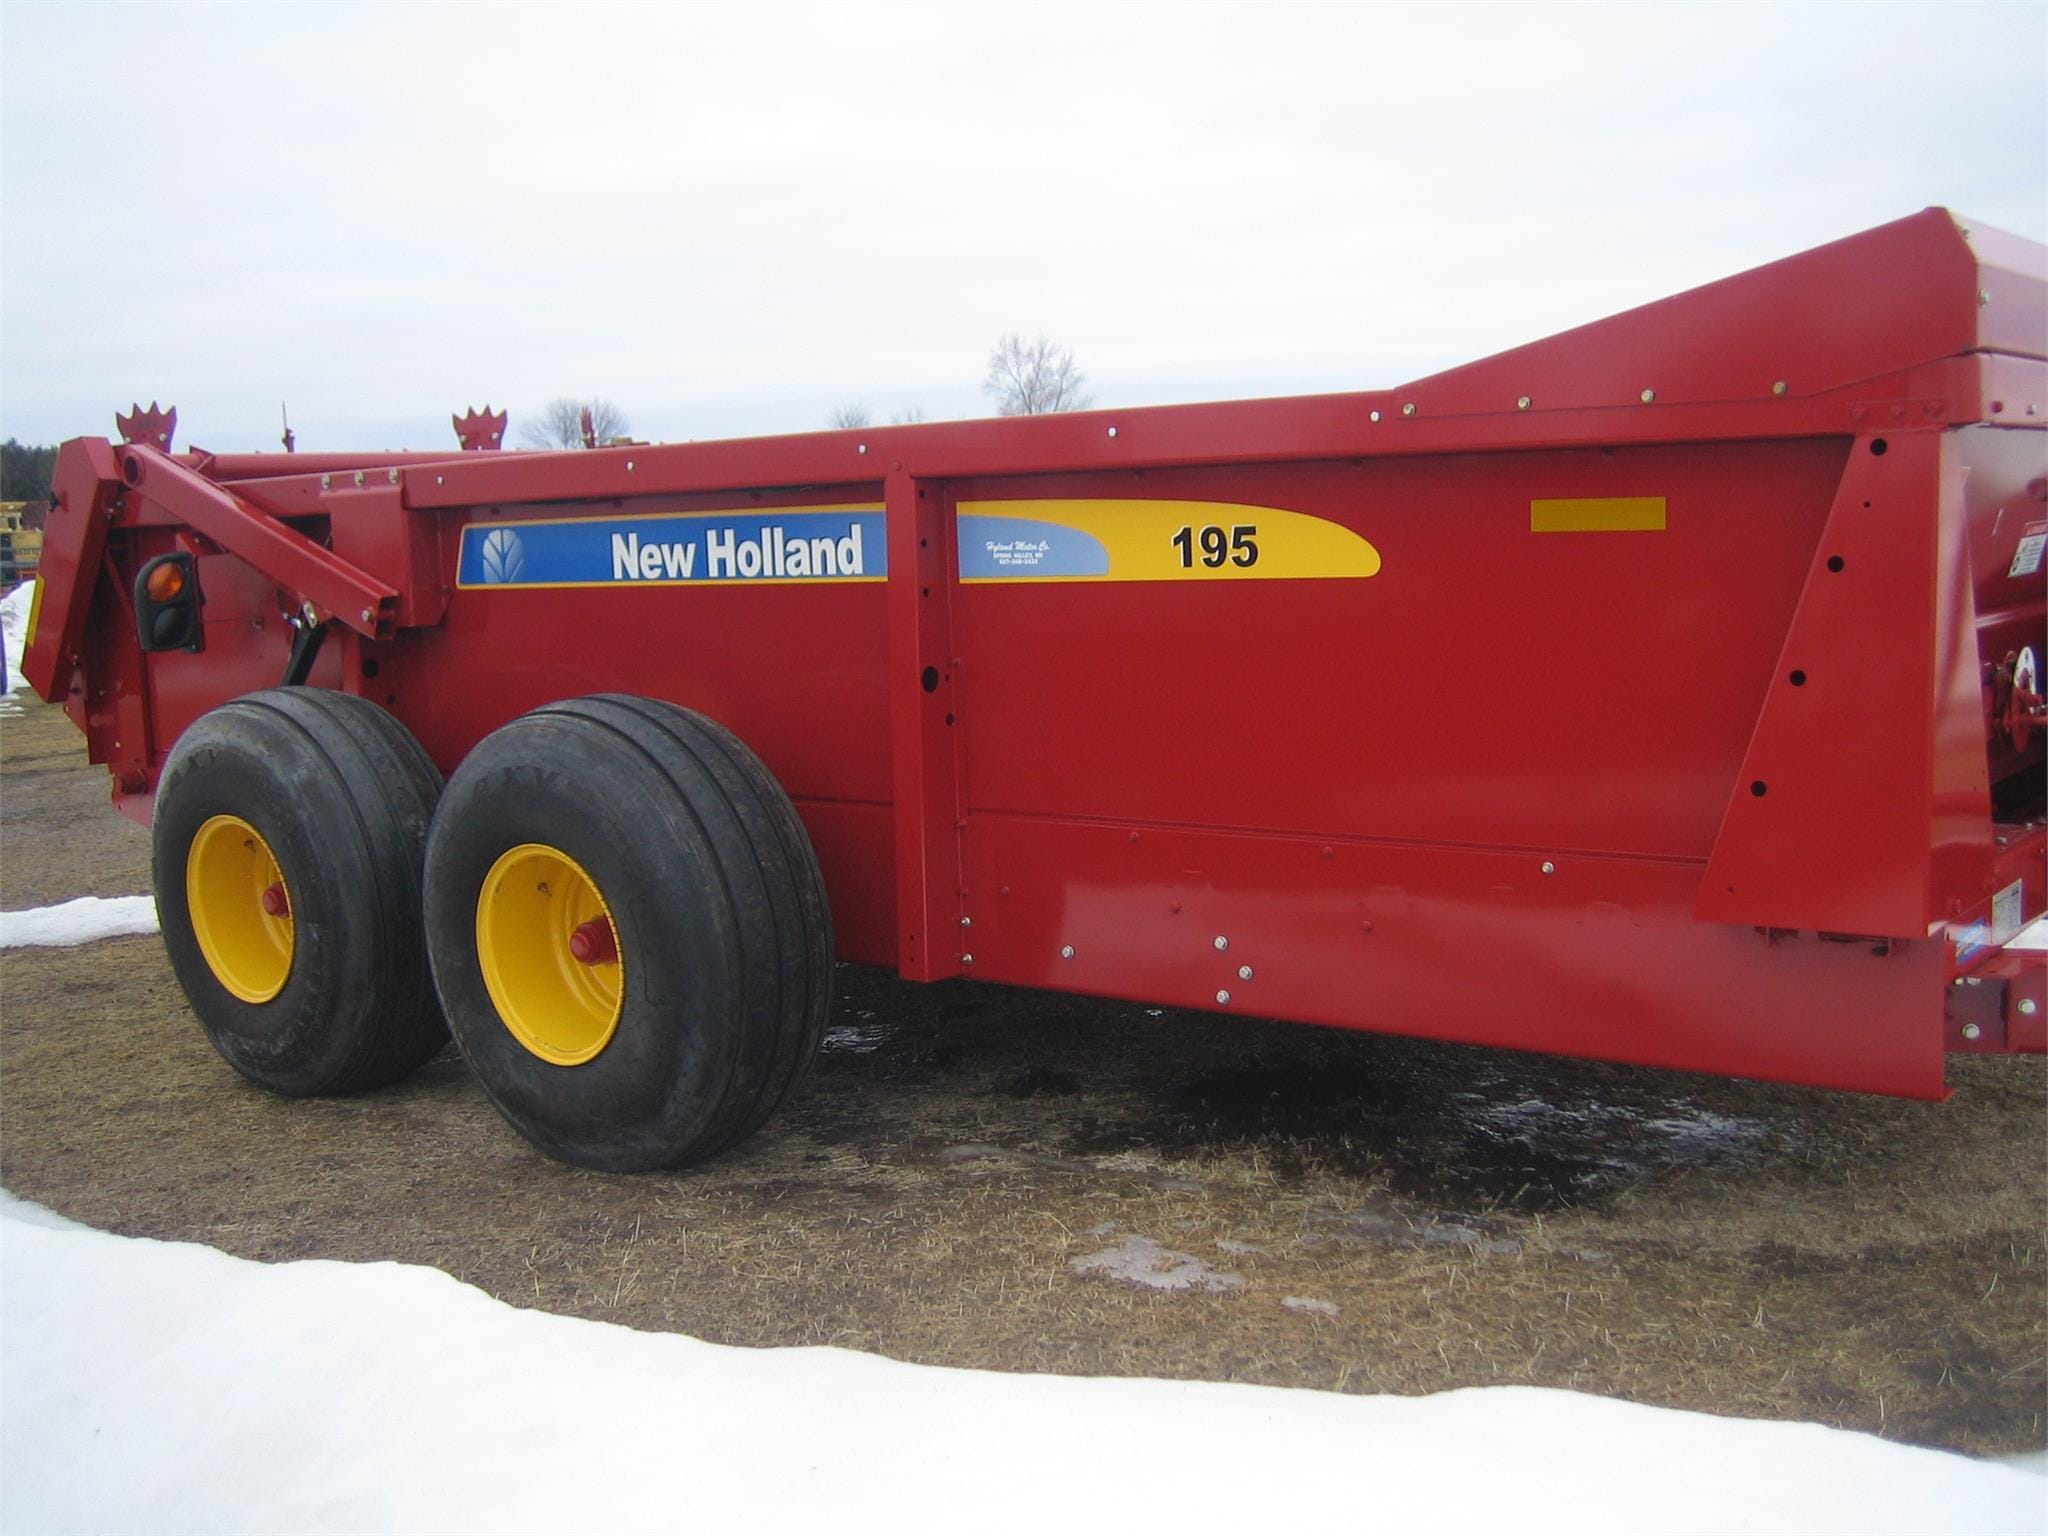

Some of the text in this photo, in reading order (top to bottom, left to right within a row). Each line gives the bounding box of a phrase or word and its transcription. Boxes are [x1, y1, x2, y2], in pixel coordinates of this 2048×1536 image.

[611, 523, 864, 580] New Holland
[1171, 525, 1260, 568] 195
